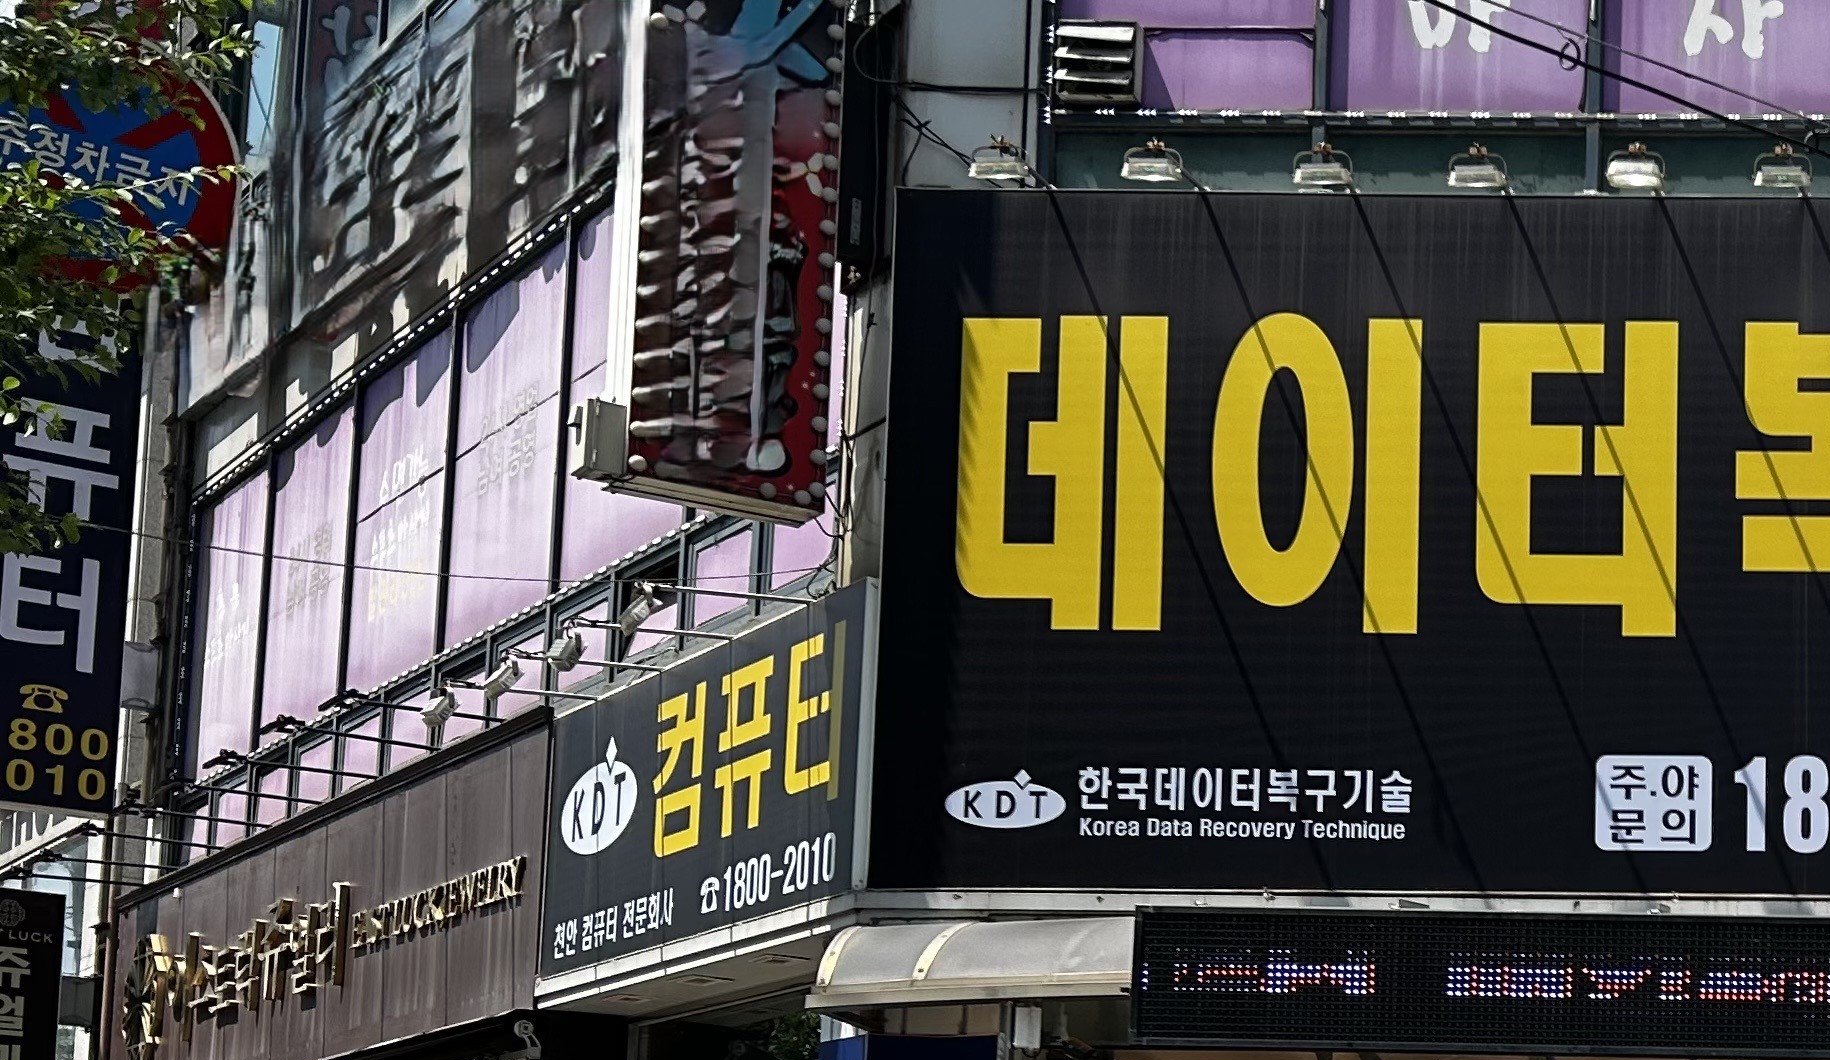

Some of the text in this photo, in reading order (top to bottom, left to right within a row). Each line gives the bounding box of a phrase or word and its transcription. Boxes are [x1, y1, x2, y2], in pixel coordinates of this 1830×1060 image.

[652, 620, 846, 858] 컴퓨터
[572, 770, 627, 843] KDT
[961, 789, 1047, 820] KDT
[1078, 766, 1413, 814] 한국데이터복구기술
[1079, 817, 1406, 841] Korea Data Recovery Technique
[1609, 808, 1697, 845] 문의
[724, 832, 837, 912] 1800-2010
[8, 930, 54, 944] LUCK
[554, 887, 674, 960] 천안 컴퓨터 전문회사
